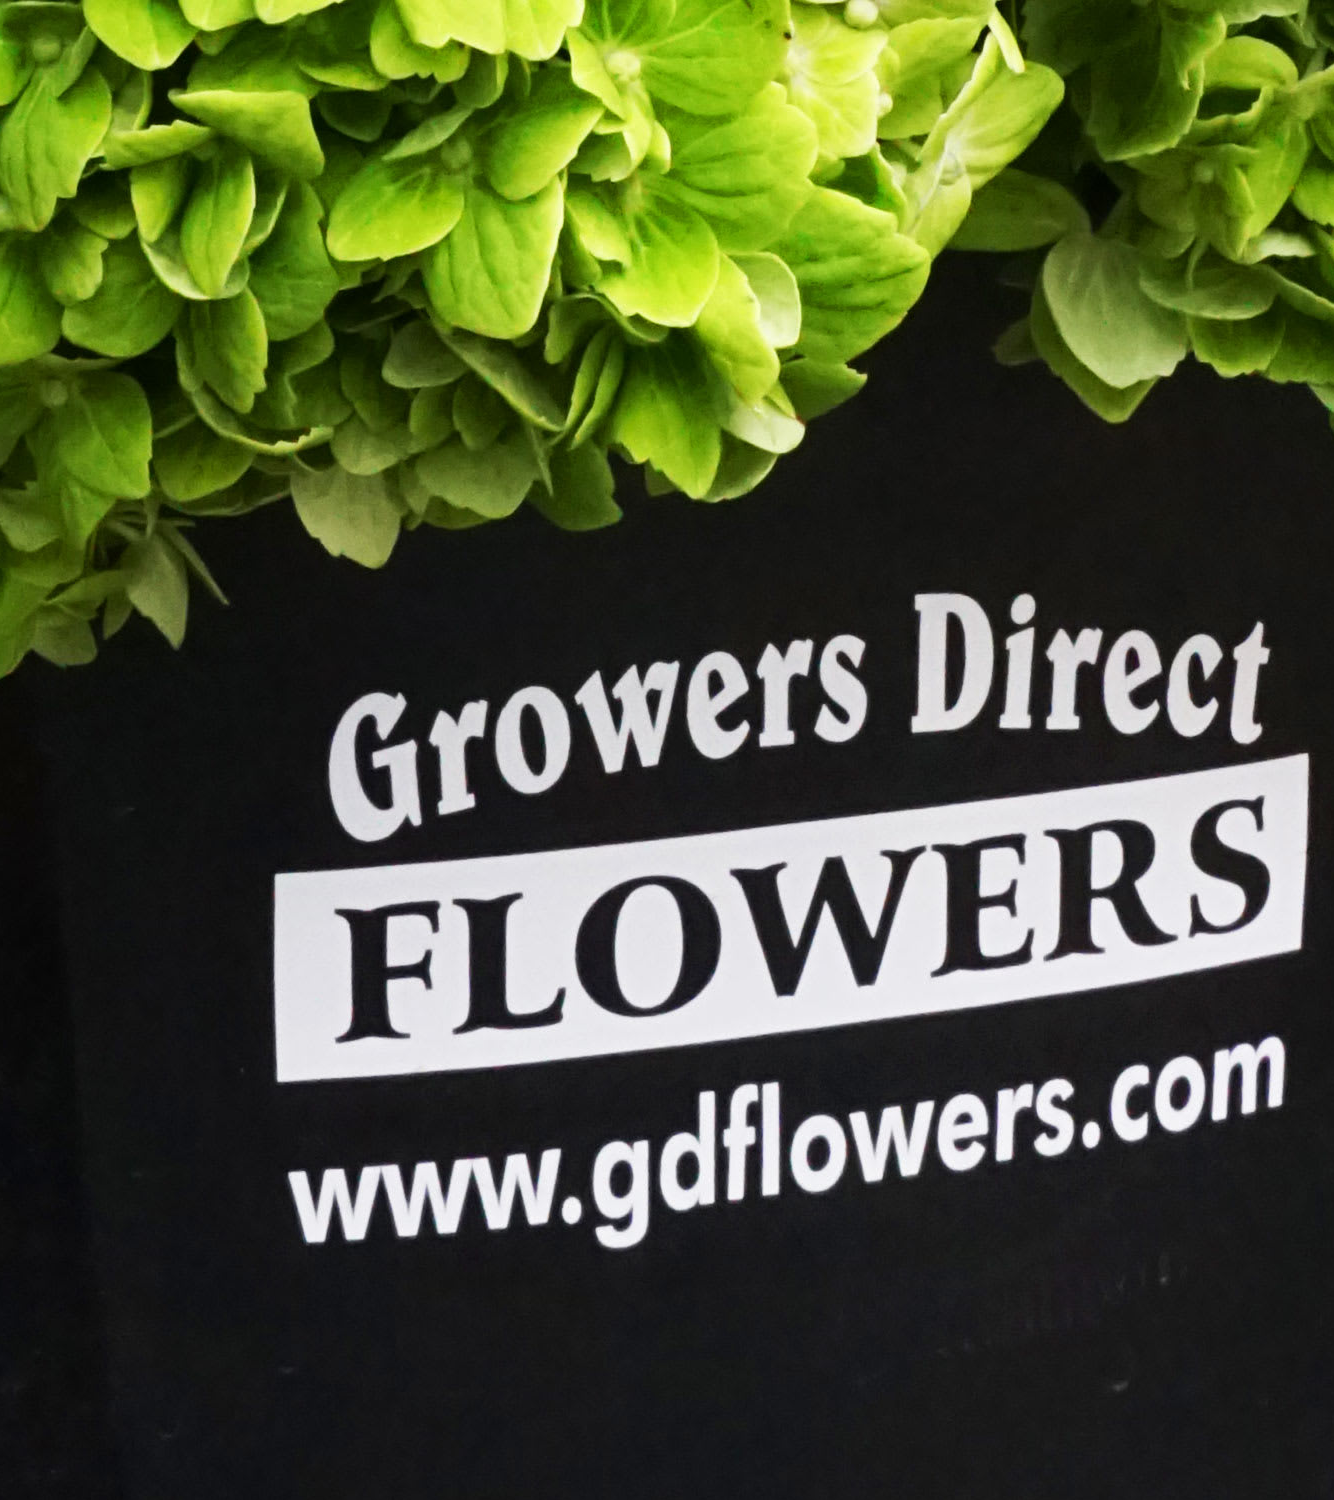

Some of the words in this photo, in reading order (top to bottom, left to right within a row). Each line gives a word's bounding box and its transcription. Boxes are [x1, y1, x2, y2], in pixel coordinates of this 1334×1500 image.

[327, 633, 868, 843] Growers
[910, 591, 1271, 745] Direct
[334, 795, 1272, 1045] FLOWERS
[287, 1034, 1287, 1250] www.gdflowers.com
